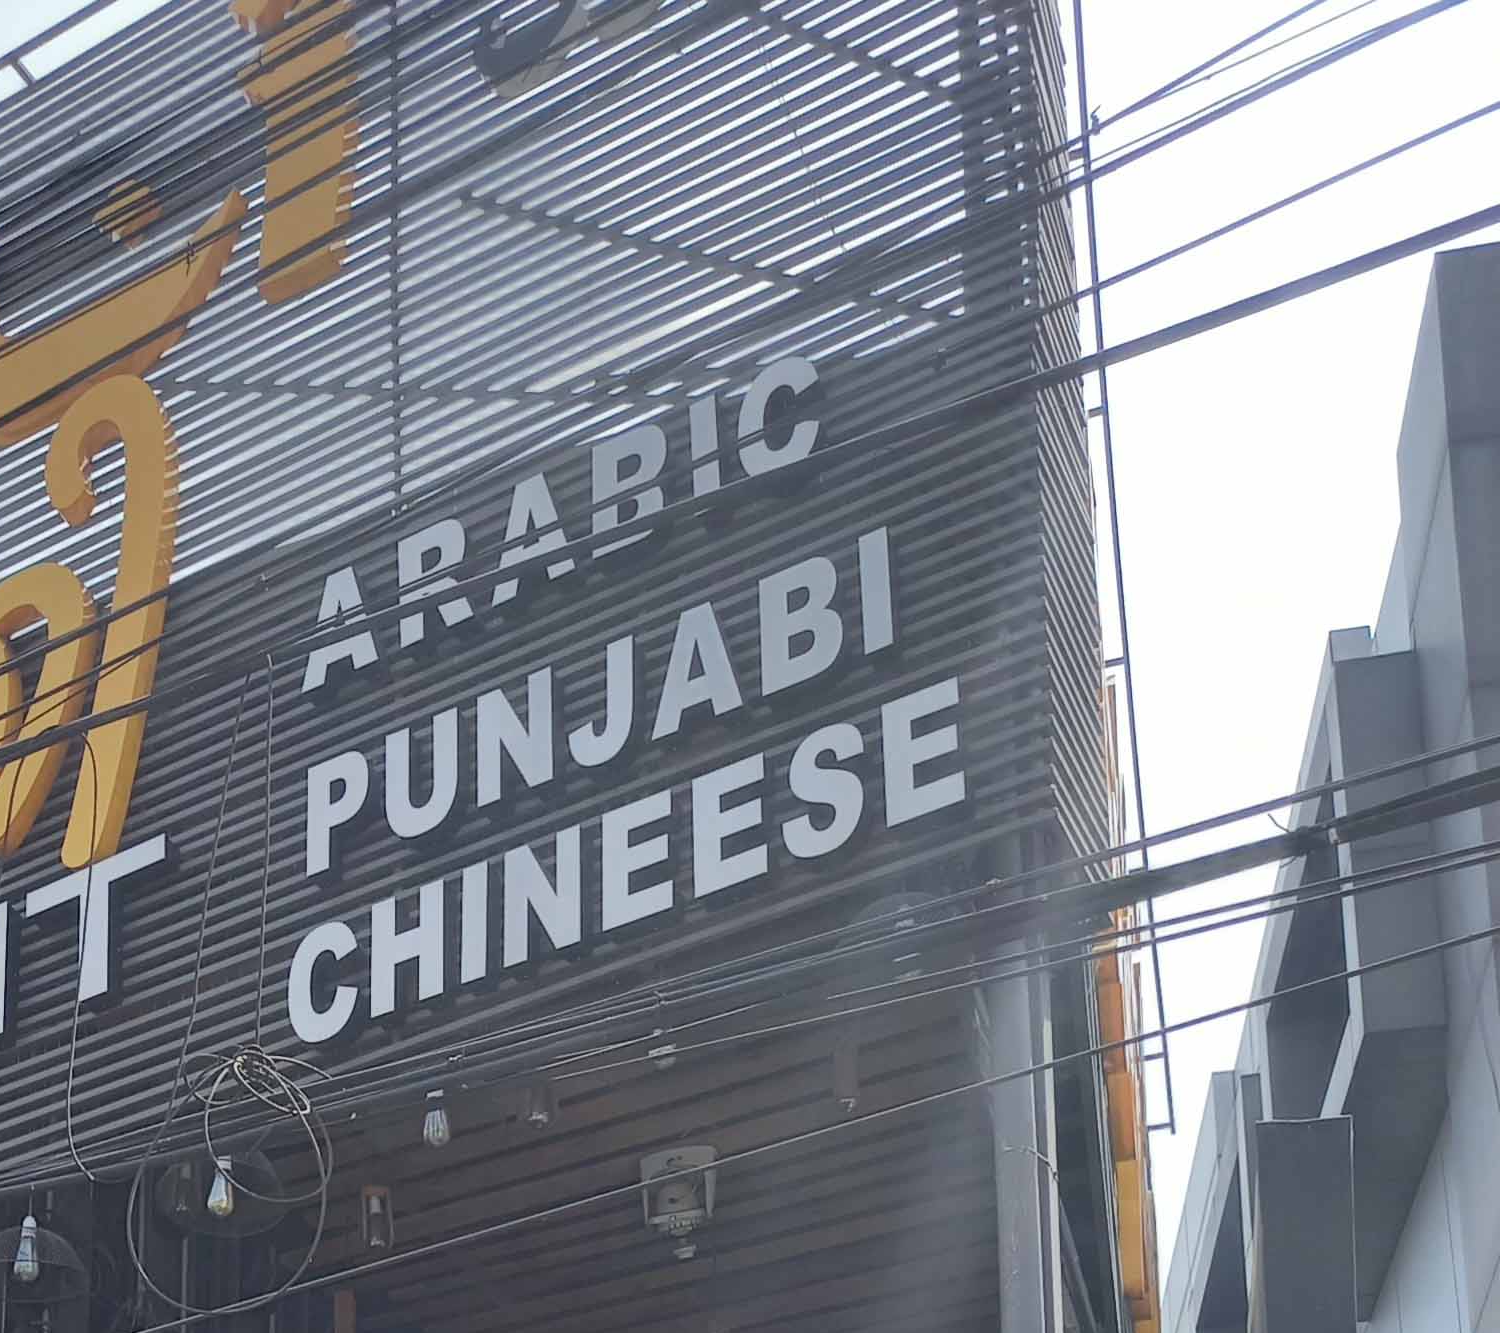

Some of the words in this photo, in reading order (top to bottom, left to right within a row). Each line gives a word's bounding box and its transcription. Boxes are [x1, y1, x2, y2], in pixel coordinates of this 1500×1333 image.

[300, 356, 821, 694] ARABIC
[306, 525, 895, 877] PUNJABI
[287, 676, 967, 1044] CHINEESE
